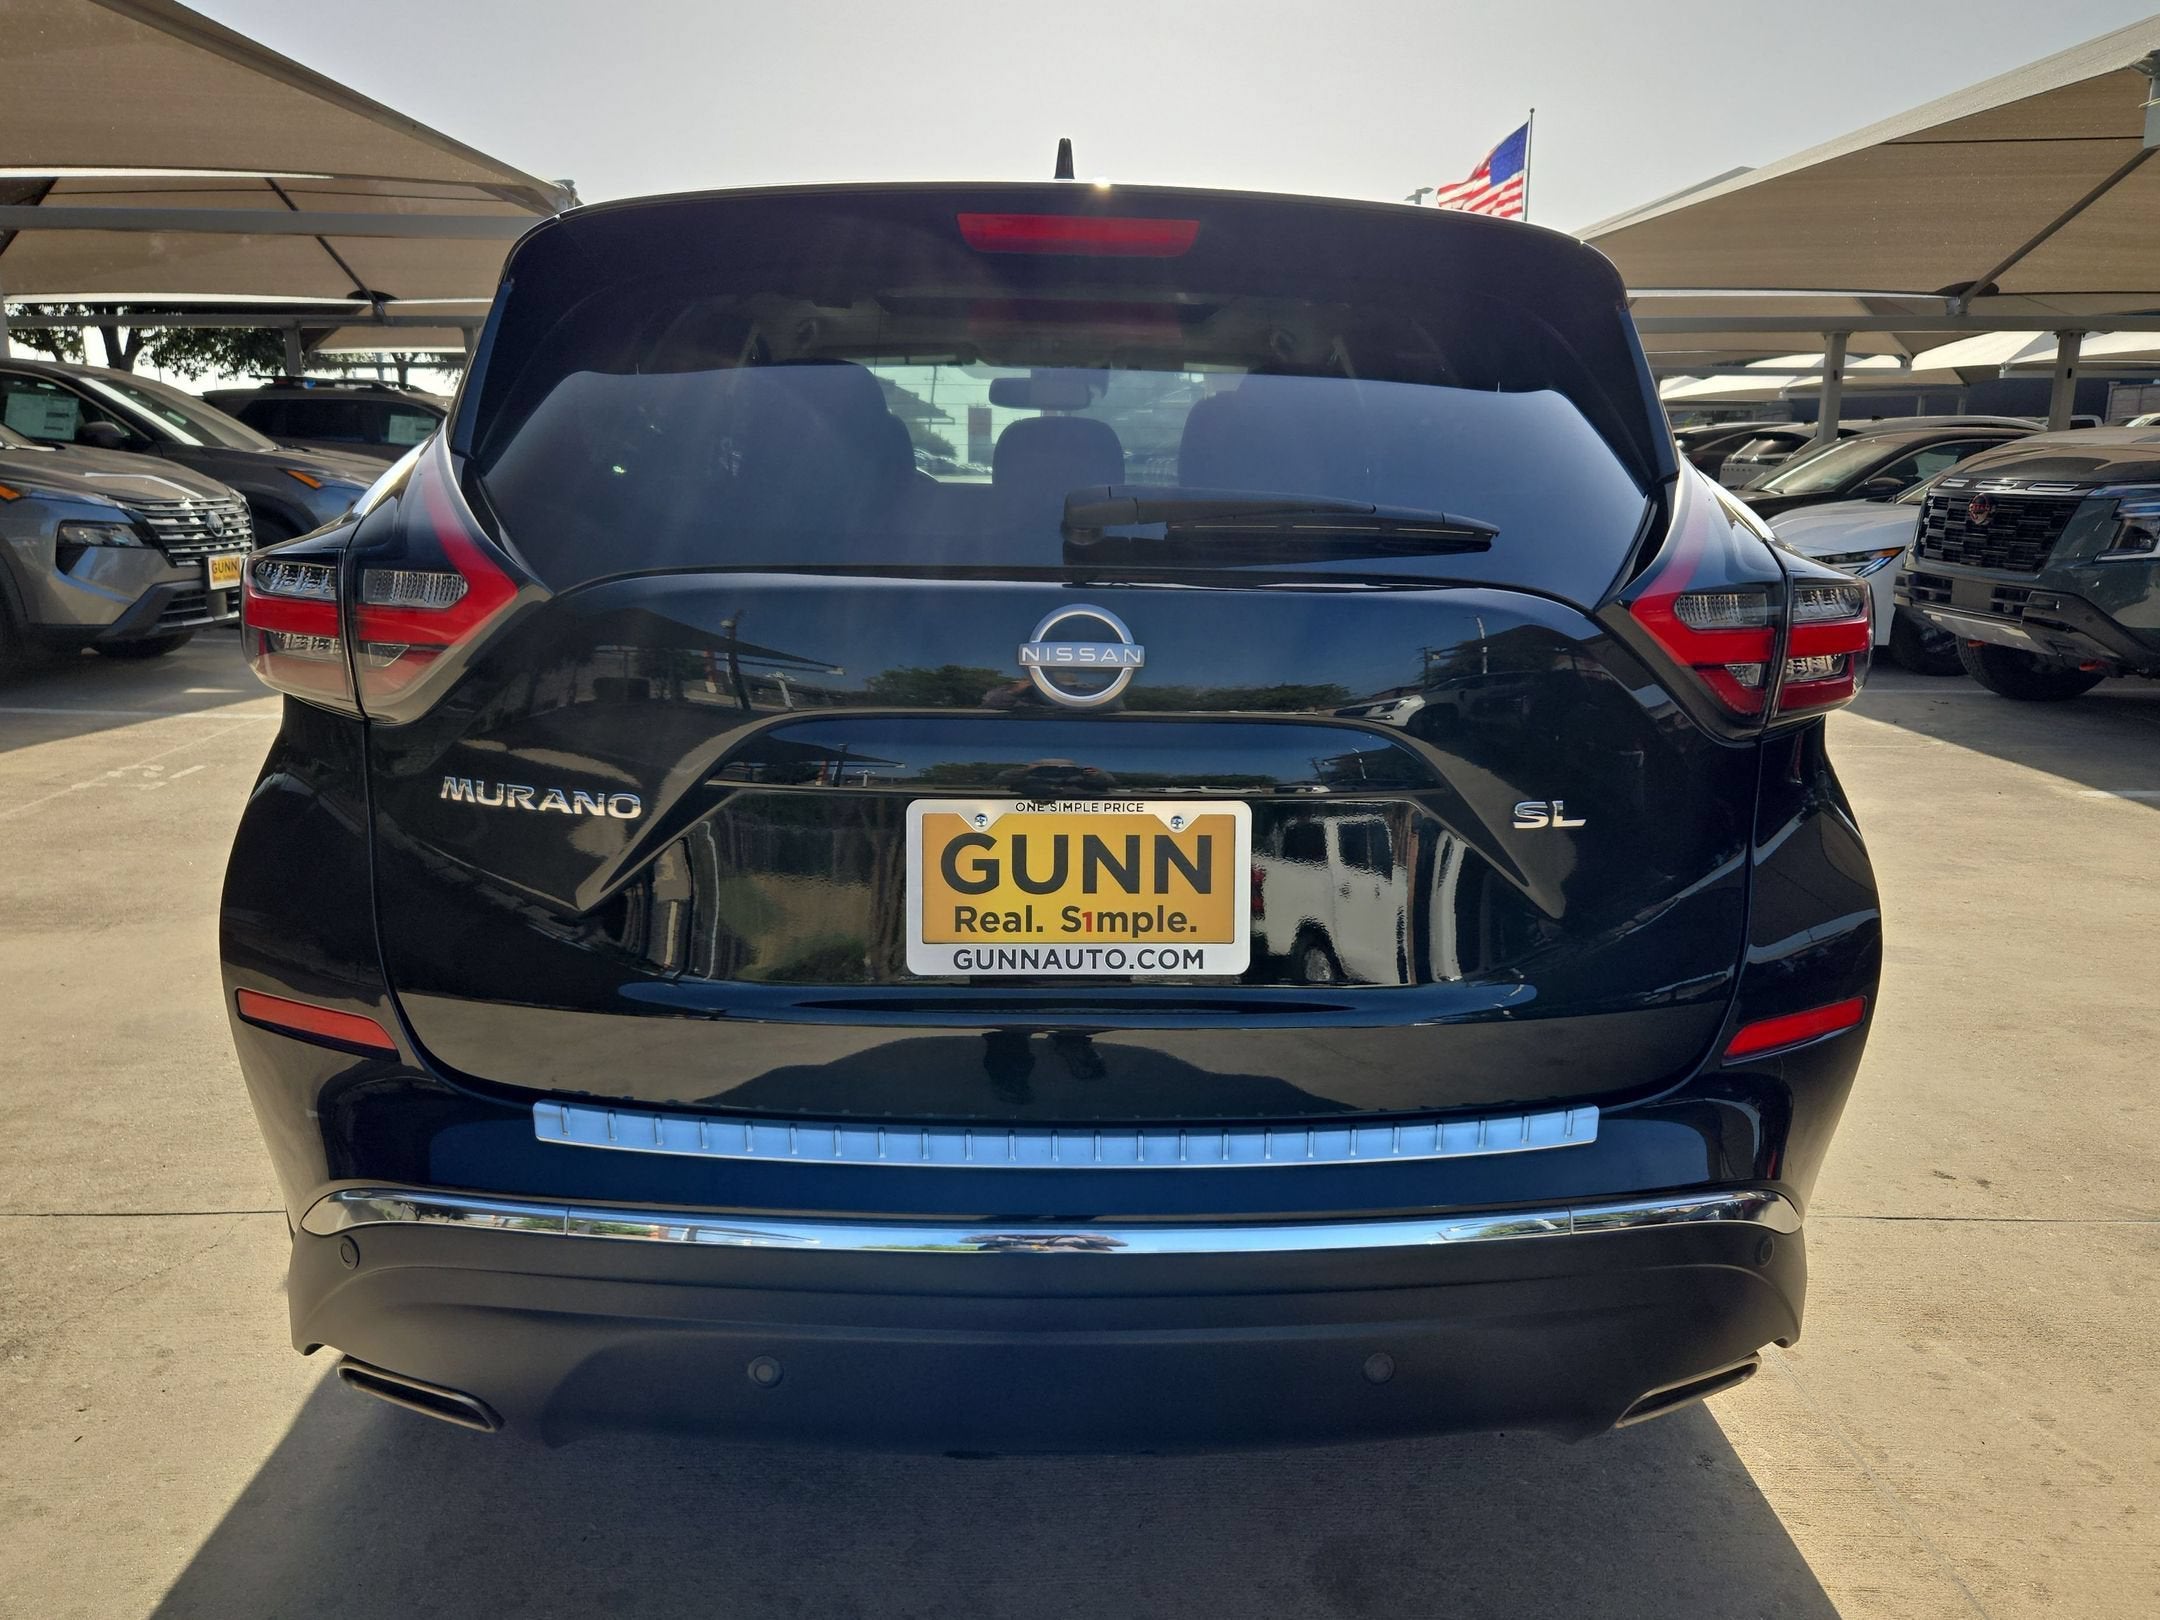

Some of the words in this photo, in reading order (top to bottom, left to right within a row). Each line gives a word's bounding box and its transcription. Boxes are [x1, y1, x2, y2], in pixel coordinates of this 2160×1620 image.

[211, 561, 237, 574] GUNN
[1021, 646, 1141, 663] NISSAN
[440, 776, 642, 819] MURANO
[1015, 802, 1045, 812] ONE
[1050, 802, 1099, 813] SIMPLE
[1104, 802, 1144, 813] PRICE
[1513, 800, 1586, 829] SL
[940, 832, 1212, 895] GUNN
[954, 905, 1044, 933] Real.
[953, 948, 1204, 970] GUNNAUTO.COM
